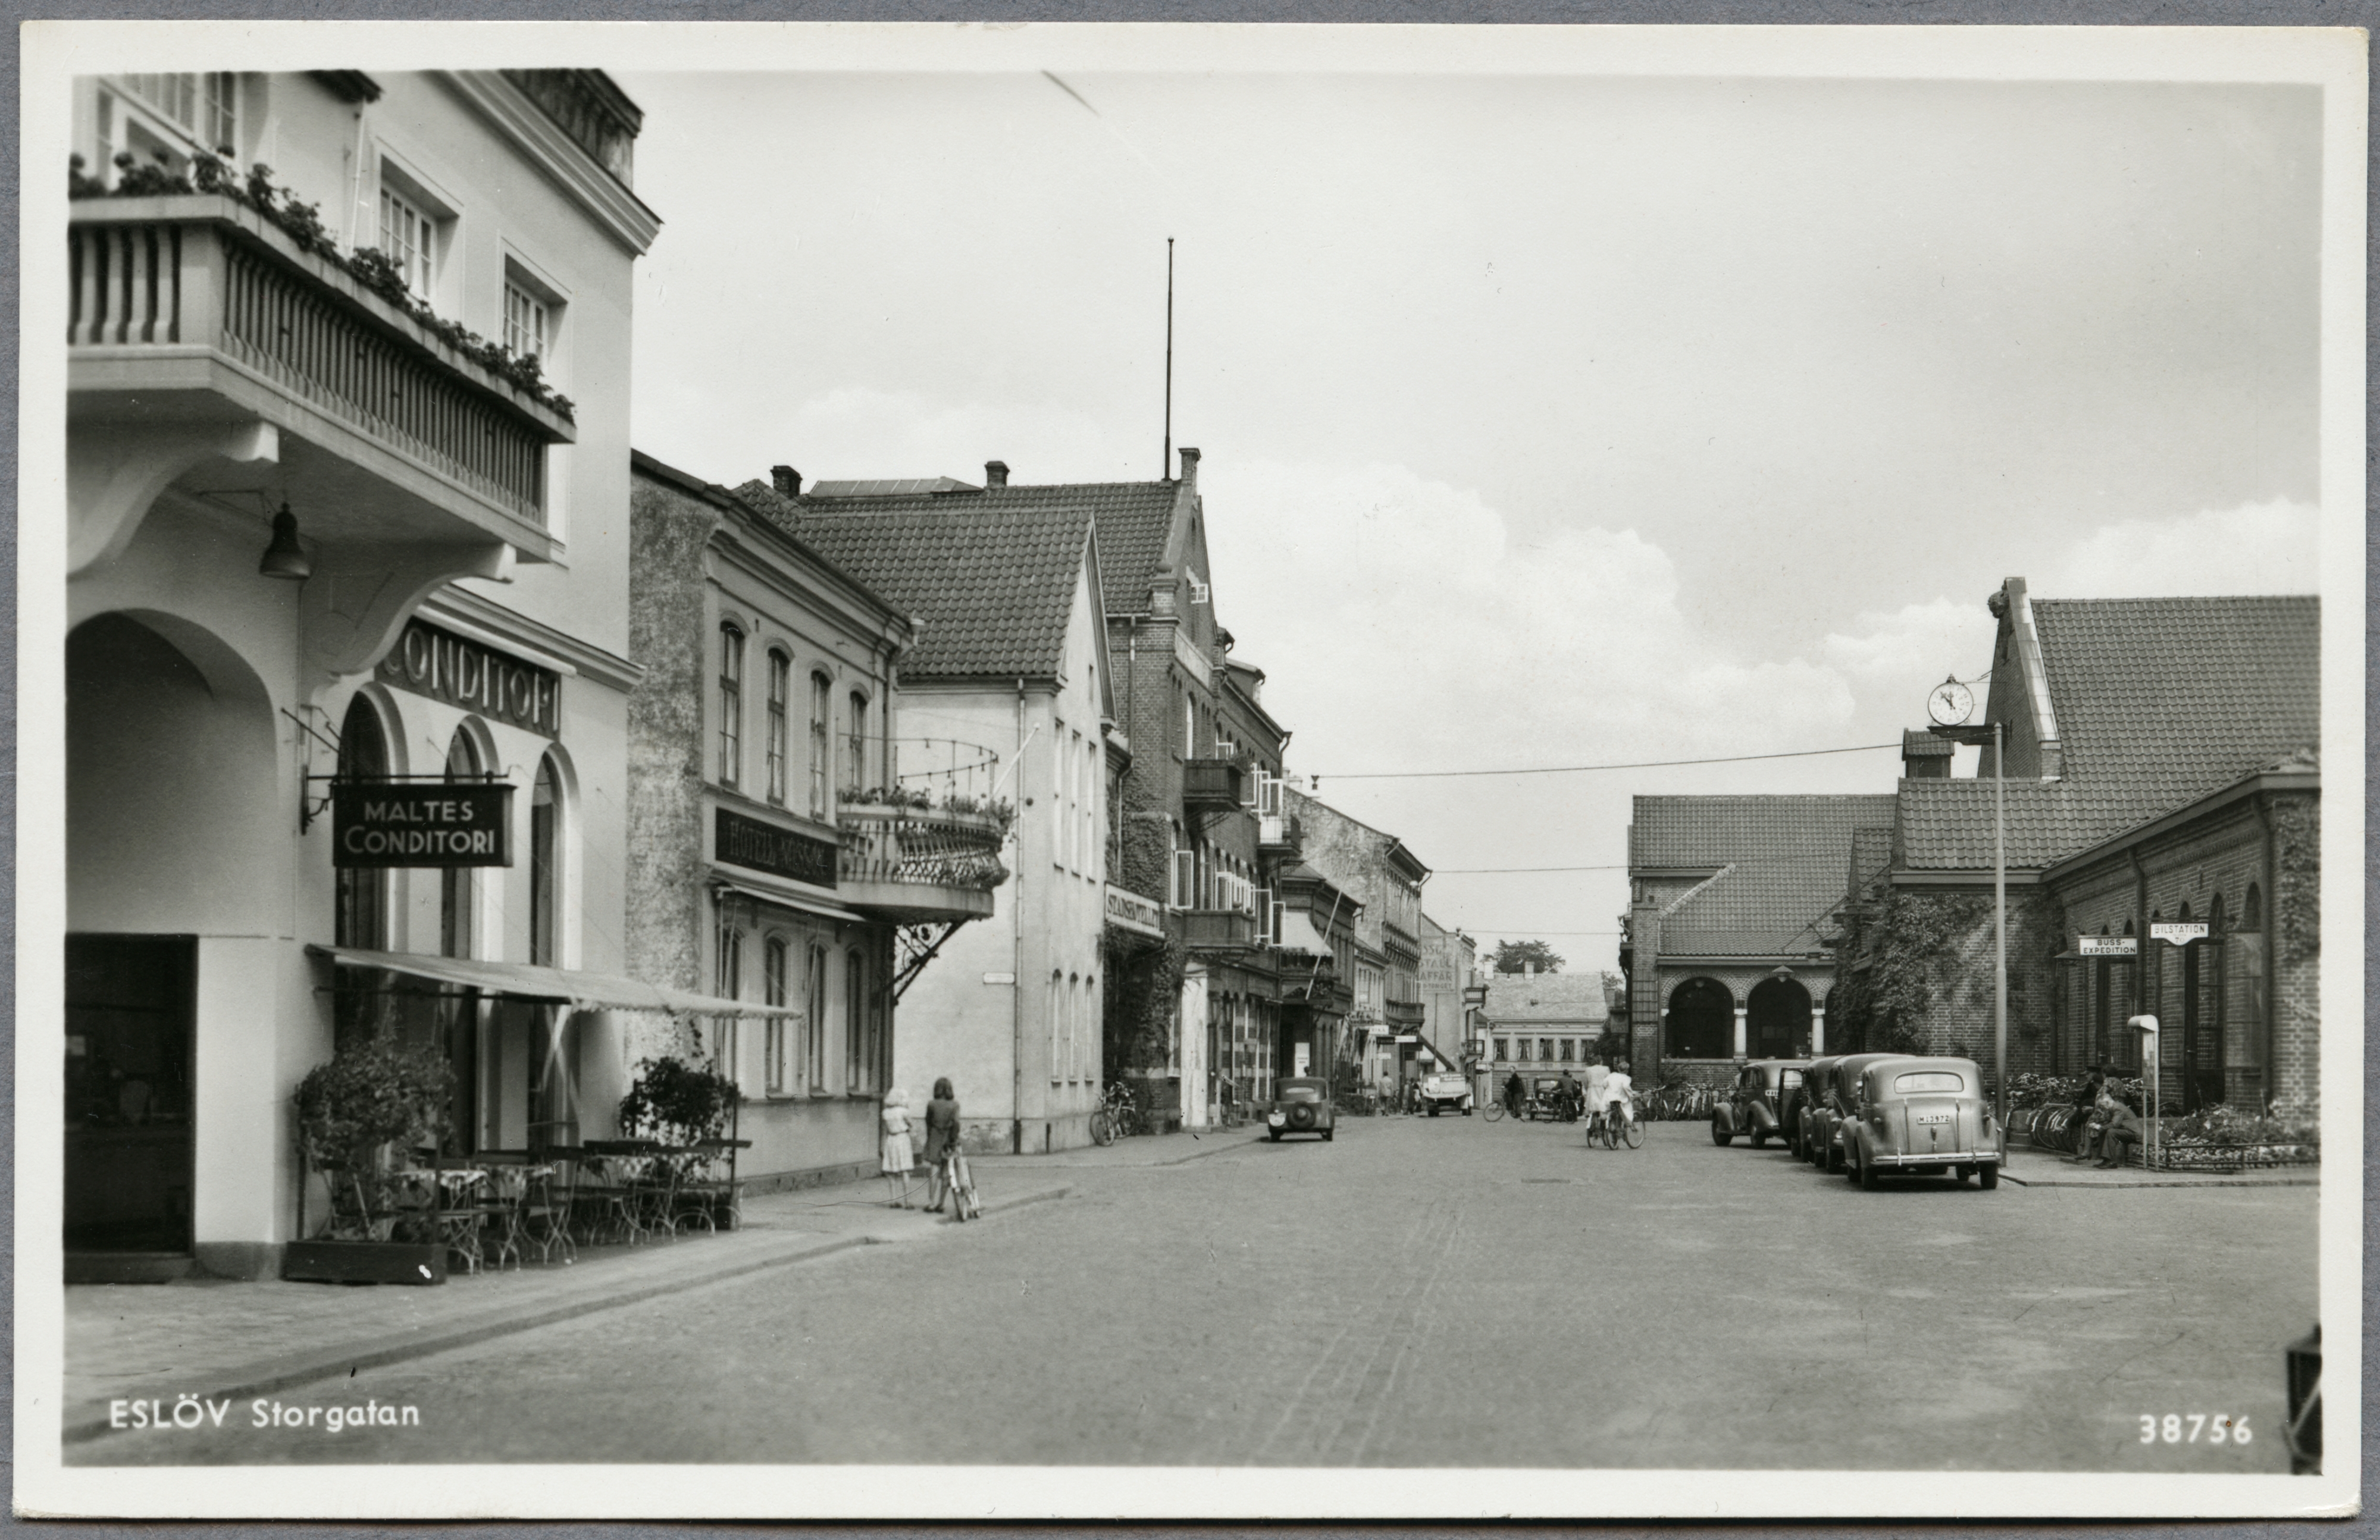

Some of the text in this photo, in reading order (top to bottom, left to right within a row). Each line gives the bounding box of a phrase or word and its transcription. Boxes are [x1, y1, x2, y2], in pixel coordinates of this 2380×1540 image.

[365, 801, 474, 822] MALTES
[345, 825, 495, 855] CONDITORI
[2154, 925, 2204, 934] BILSTATION
